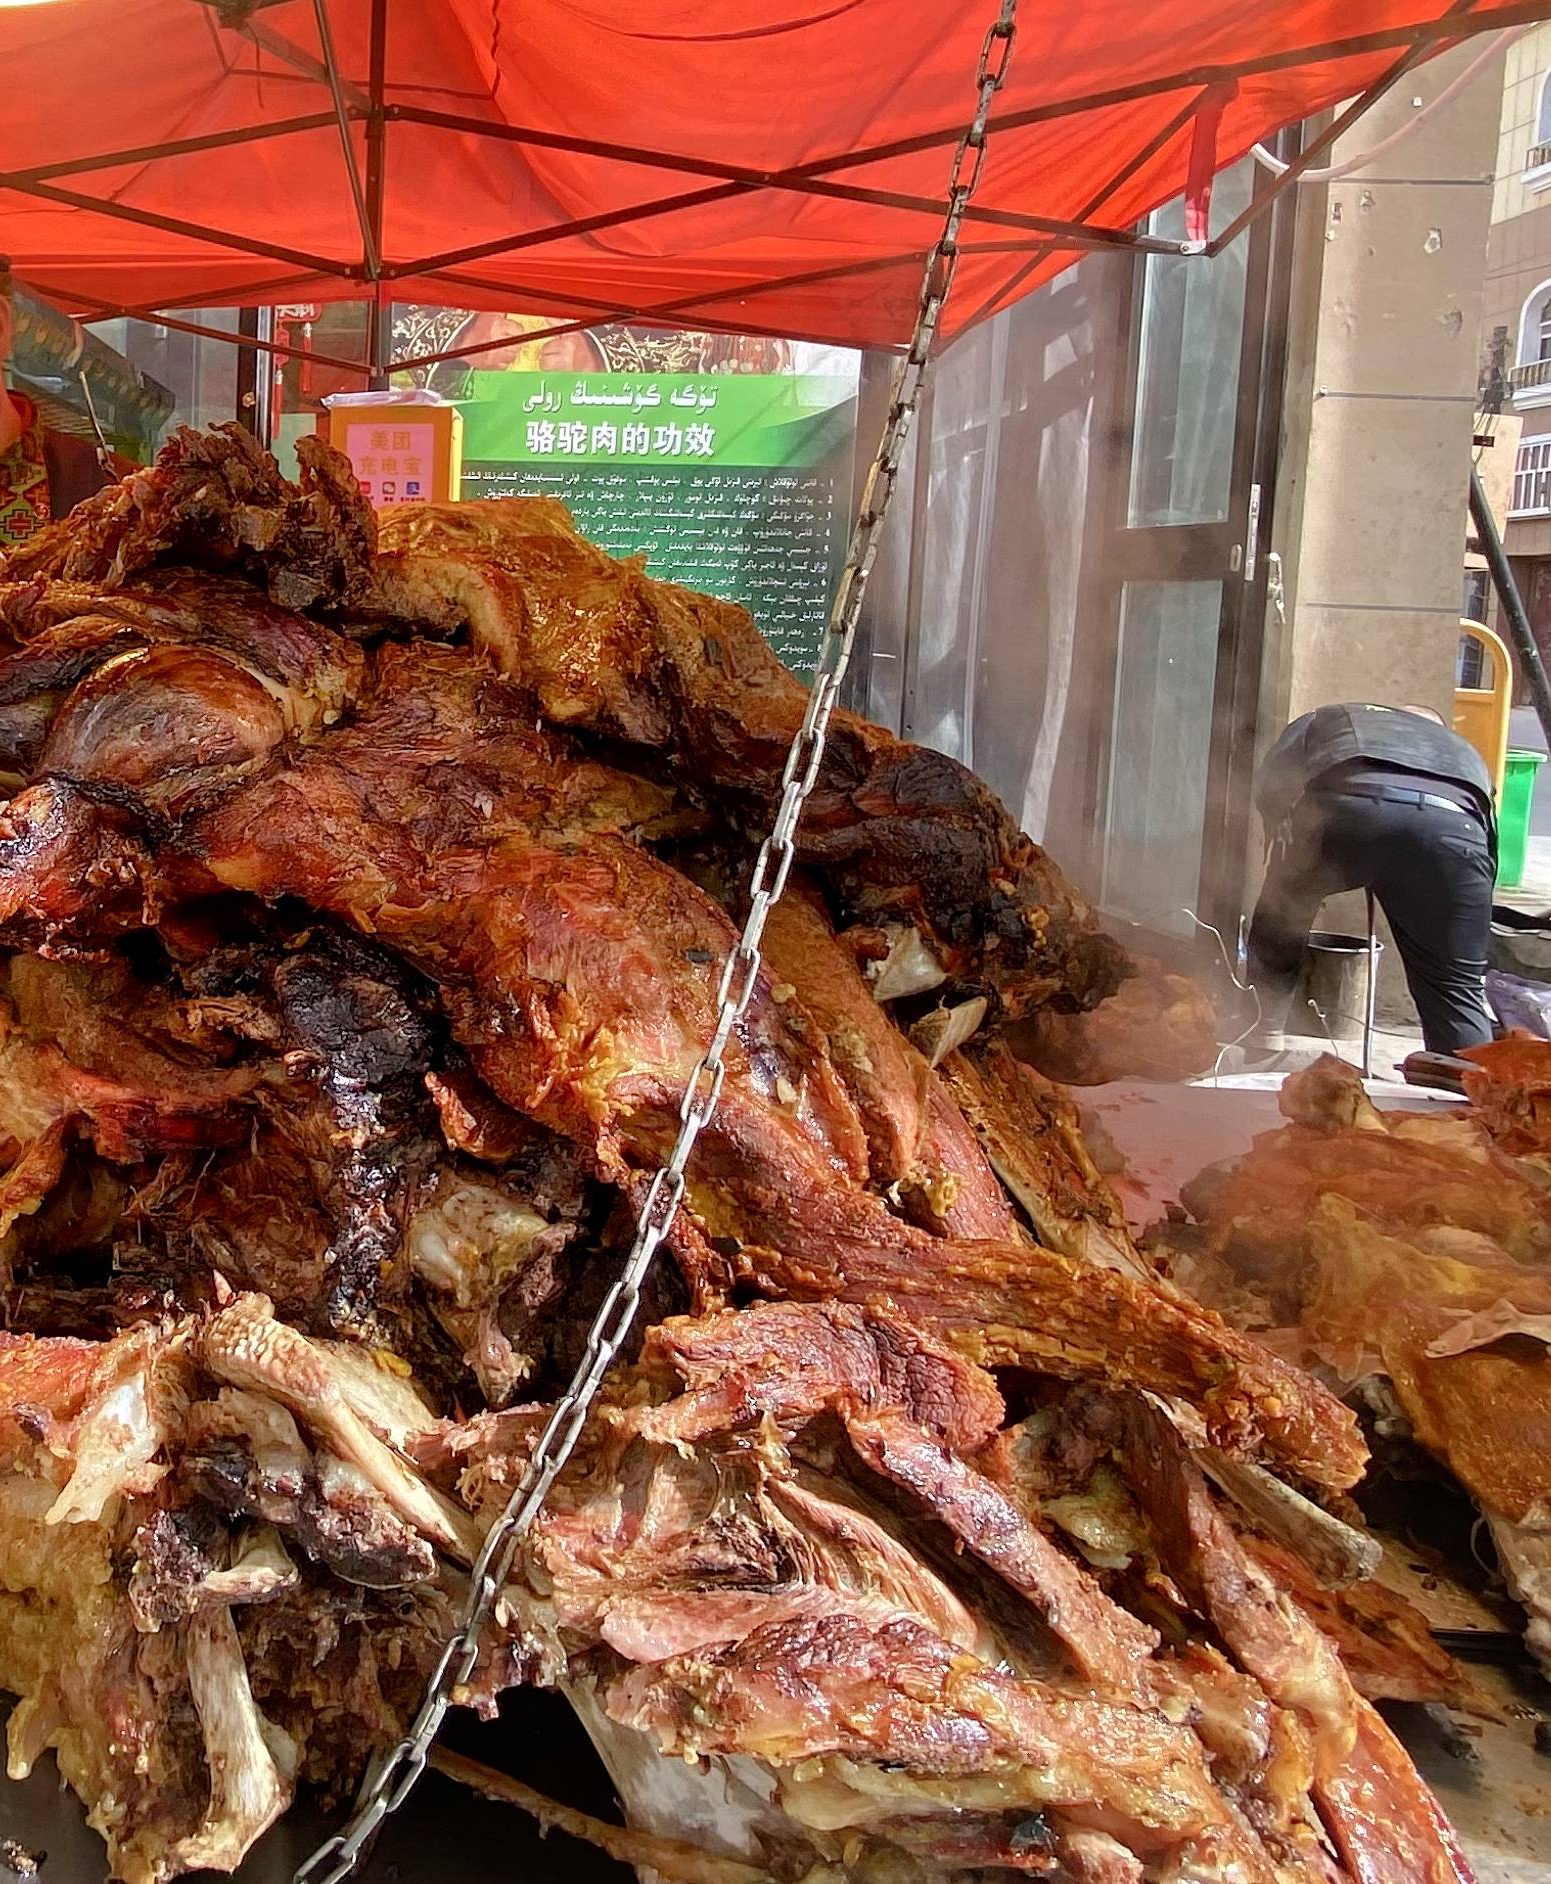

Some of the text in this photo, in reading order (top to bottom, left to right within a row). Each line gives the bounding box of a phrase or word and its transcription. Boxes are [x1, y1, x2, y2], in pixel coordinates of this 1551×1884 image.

[522, 379, 563, 413] رولى
[370, 430, 411, 450] 美团
[525, 420, 716, 457] 骆驼肉的功效
[359, 455, 422, 475] 充电宝
